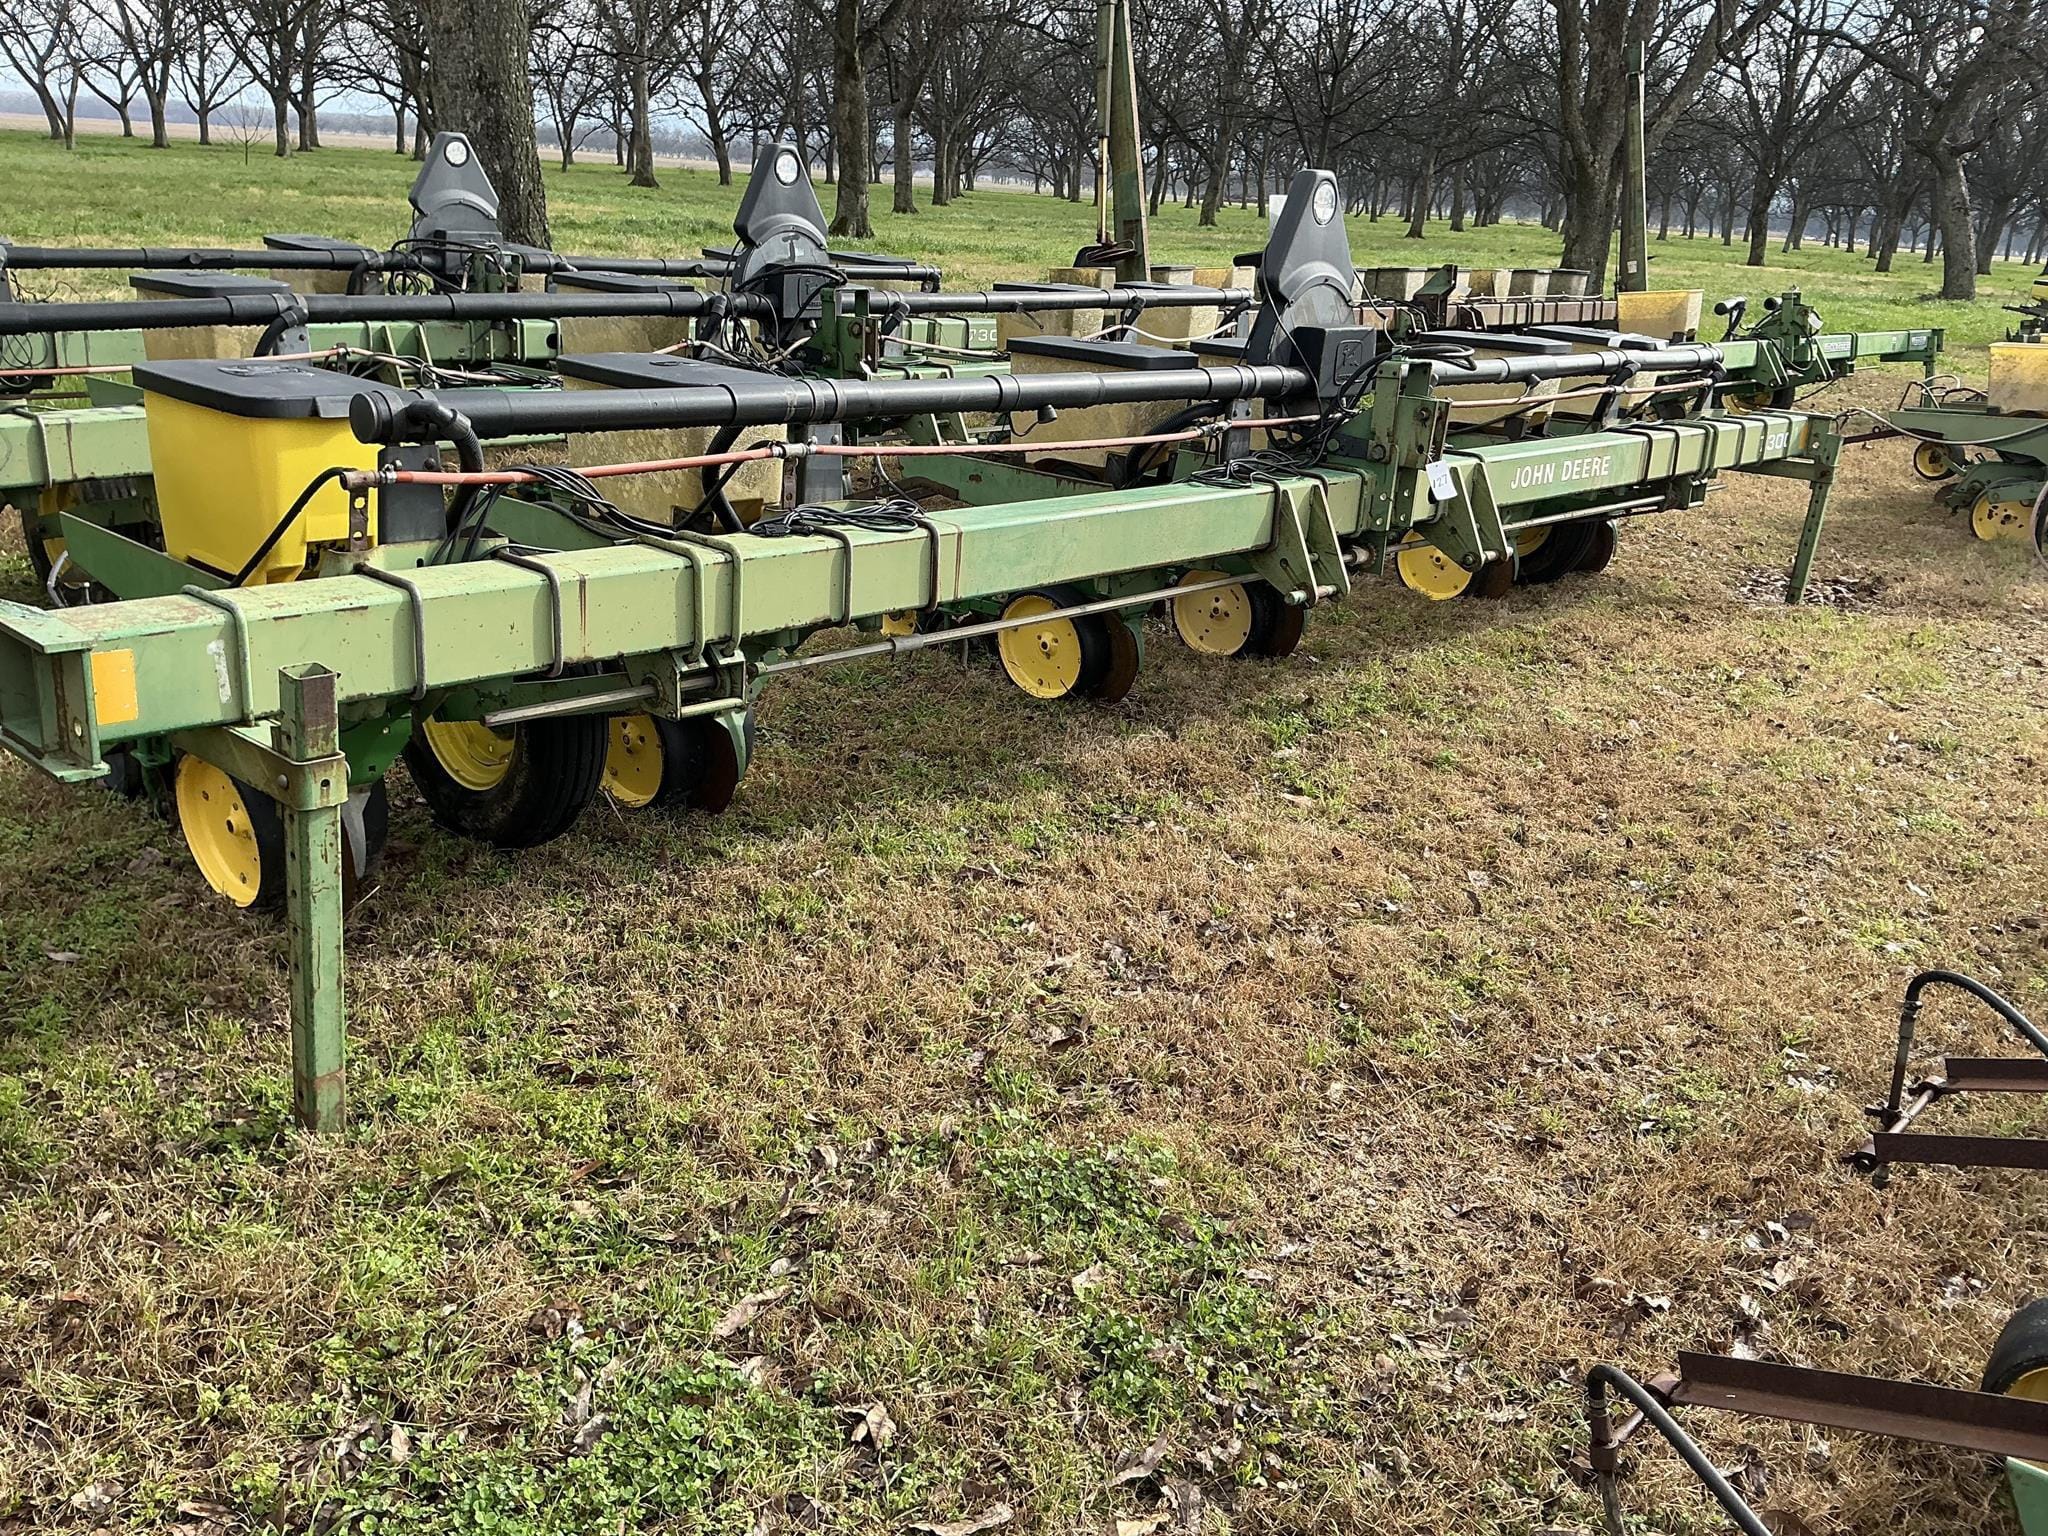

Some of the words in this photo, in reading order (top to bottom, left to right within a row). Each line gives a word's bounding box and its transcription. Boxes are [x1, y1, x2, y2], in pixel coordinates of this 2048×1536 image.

[1433, 474, 1447, 489] 127
[1510, 463, 1555, 489] JOHN
[1560, 456, 1611, 481] DEERE
